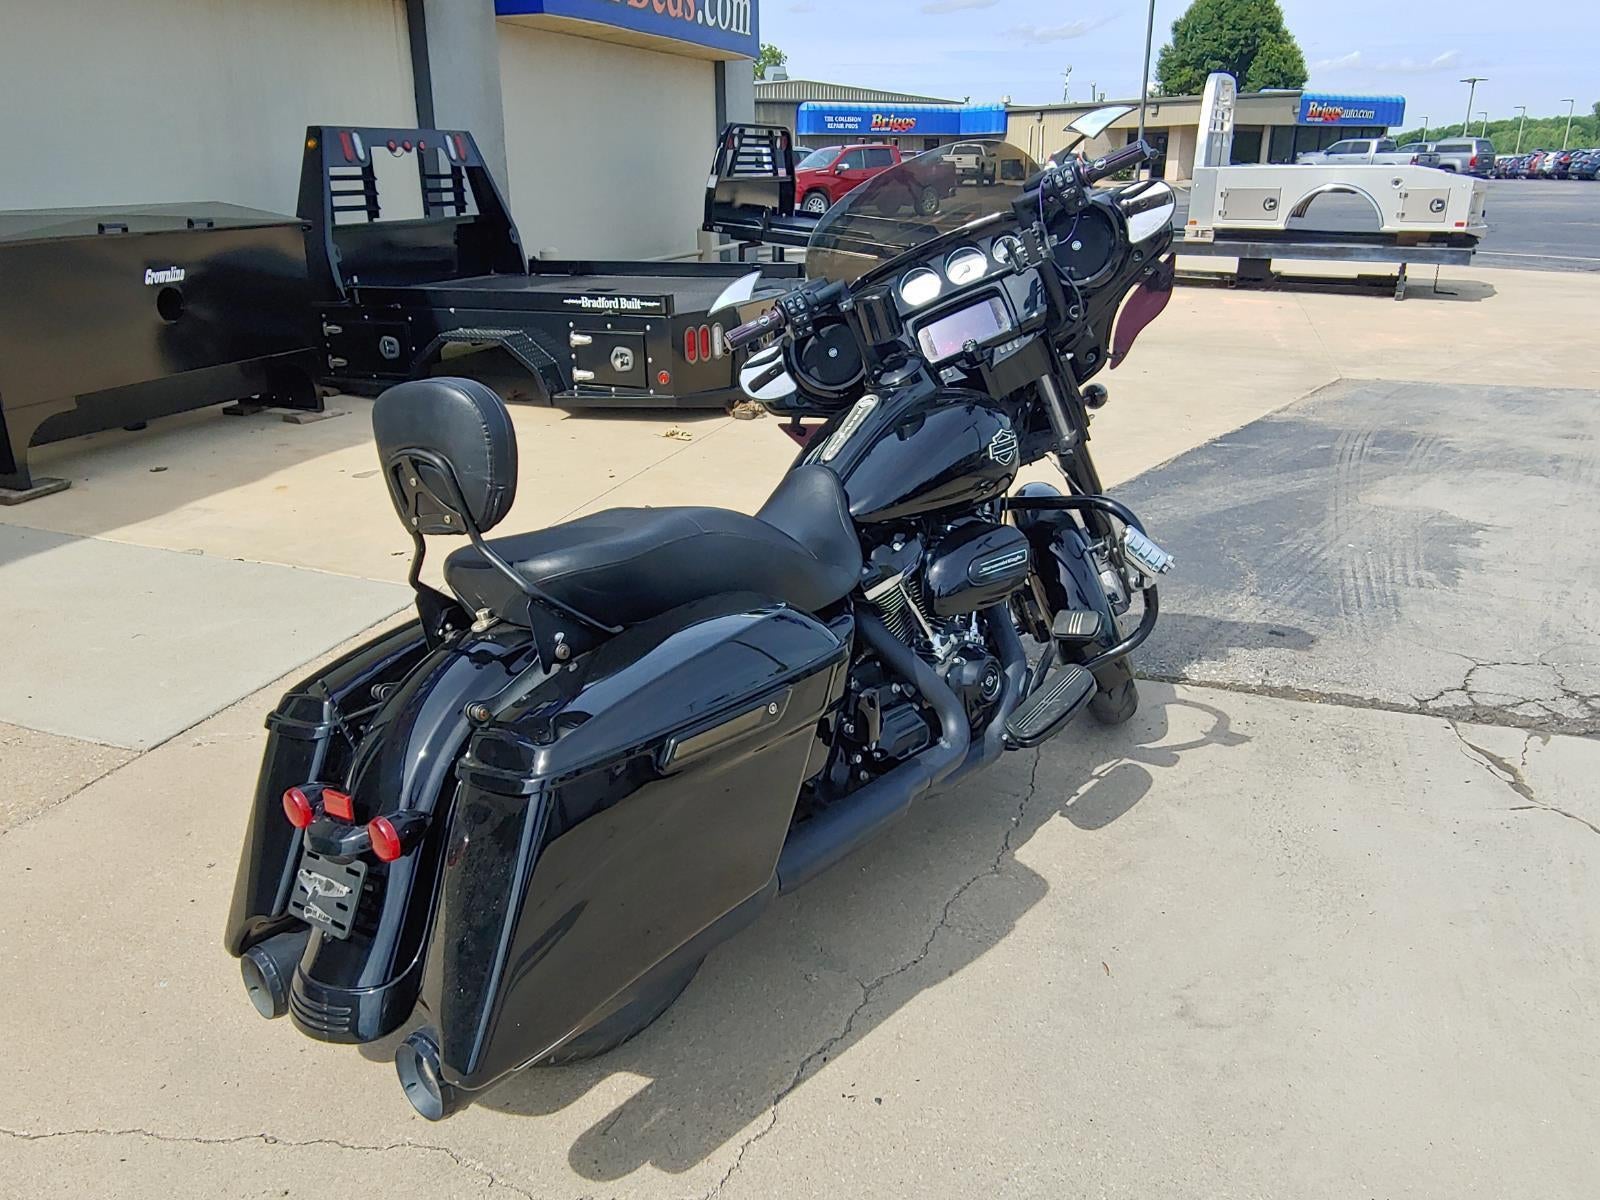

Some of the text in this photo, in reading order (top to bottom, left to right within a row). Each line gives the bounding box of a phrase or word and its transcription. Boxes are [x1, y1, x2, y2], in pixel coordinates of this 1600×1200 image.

[871, 113, 917, 133] Briggs
[144, 266, 185, 285] Crownline
[580, 296, 641, 310] Bradford Built
